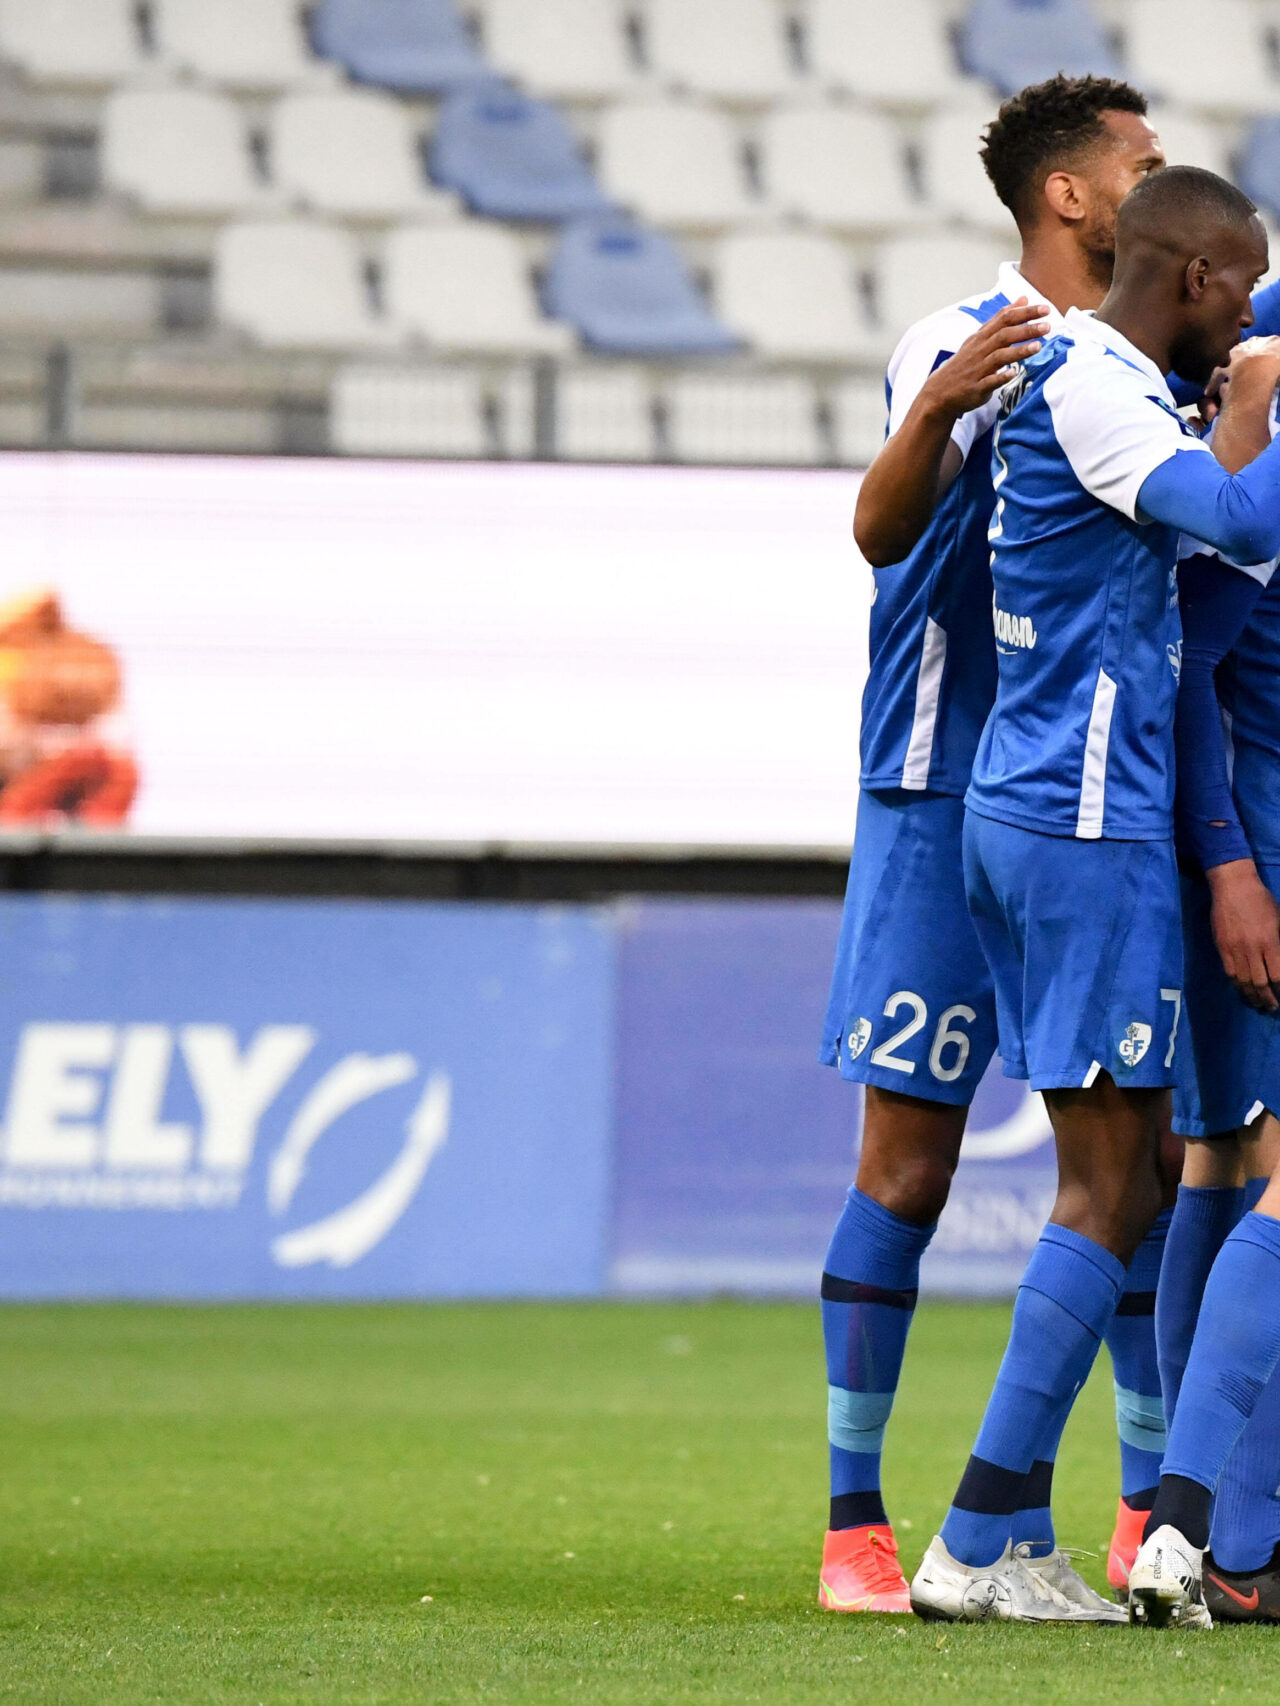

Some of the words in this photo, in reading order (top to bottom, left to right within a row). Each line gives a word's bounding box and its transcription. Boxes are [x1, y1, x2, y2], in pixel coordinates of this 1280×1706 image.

[870, 990, 977, 1082] 26
[1119, 1039, 1145, 1056] GF
[1160, 988, 1182, 1068] 7
